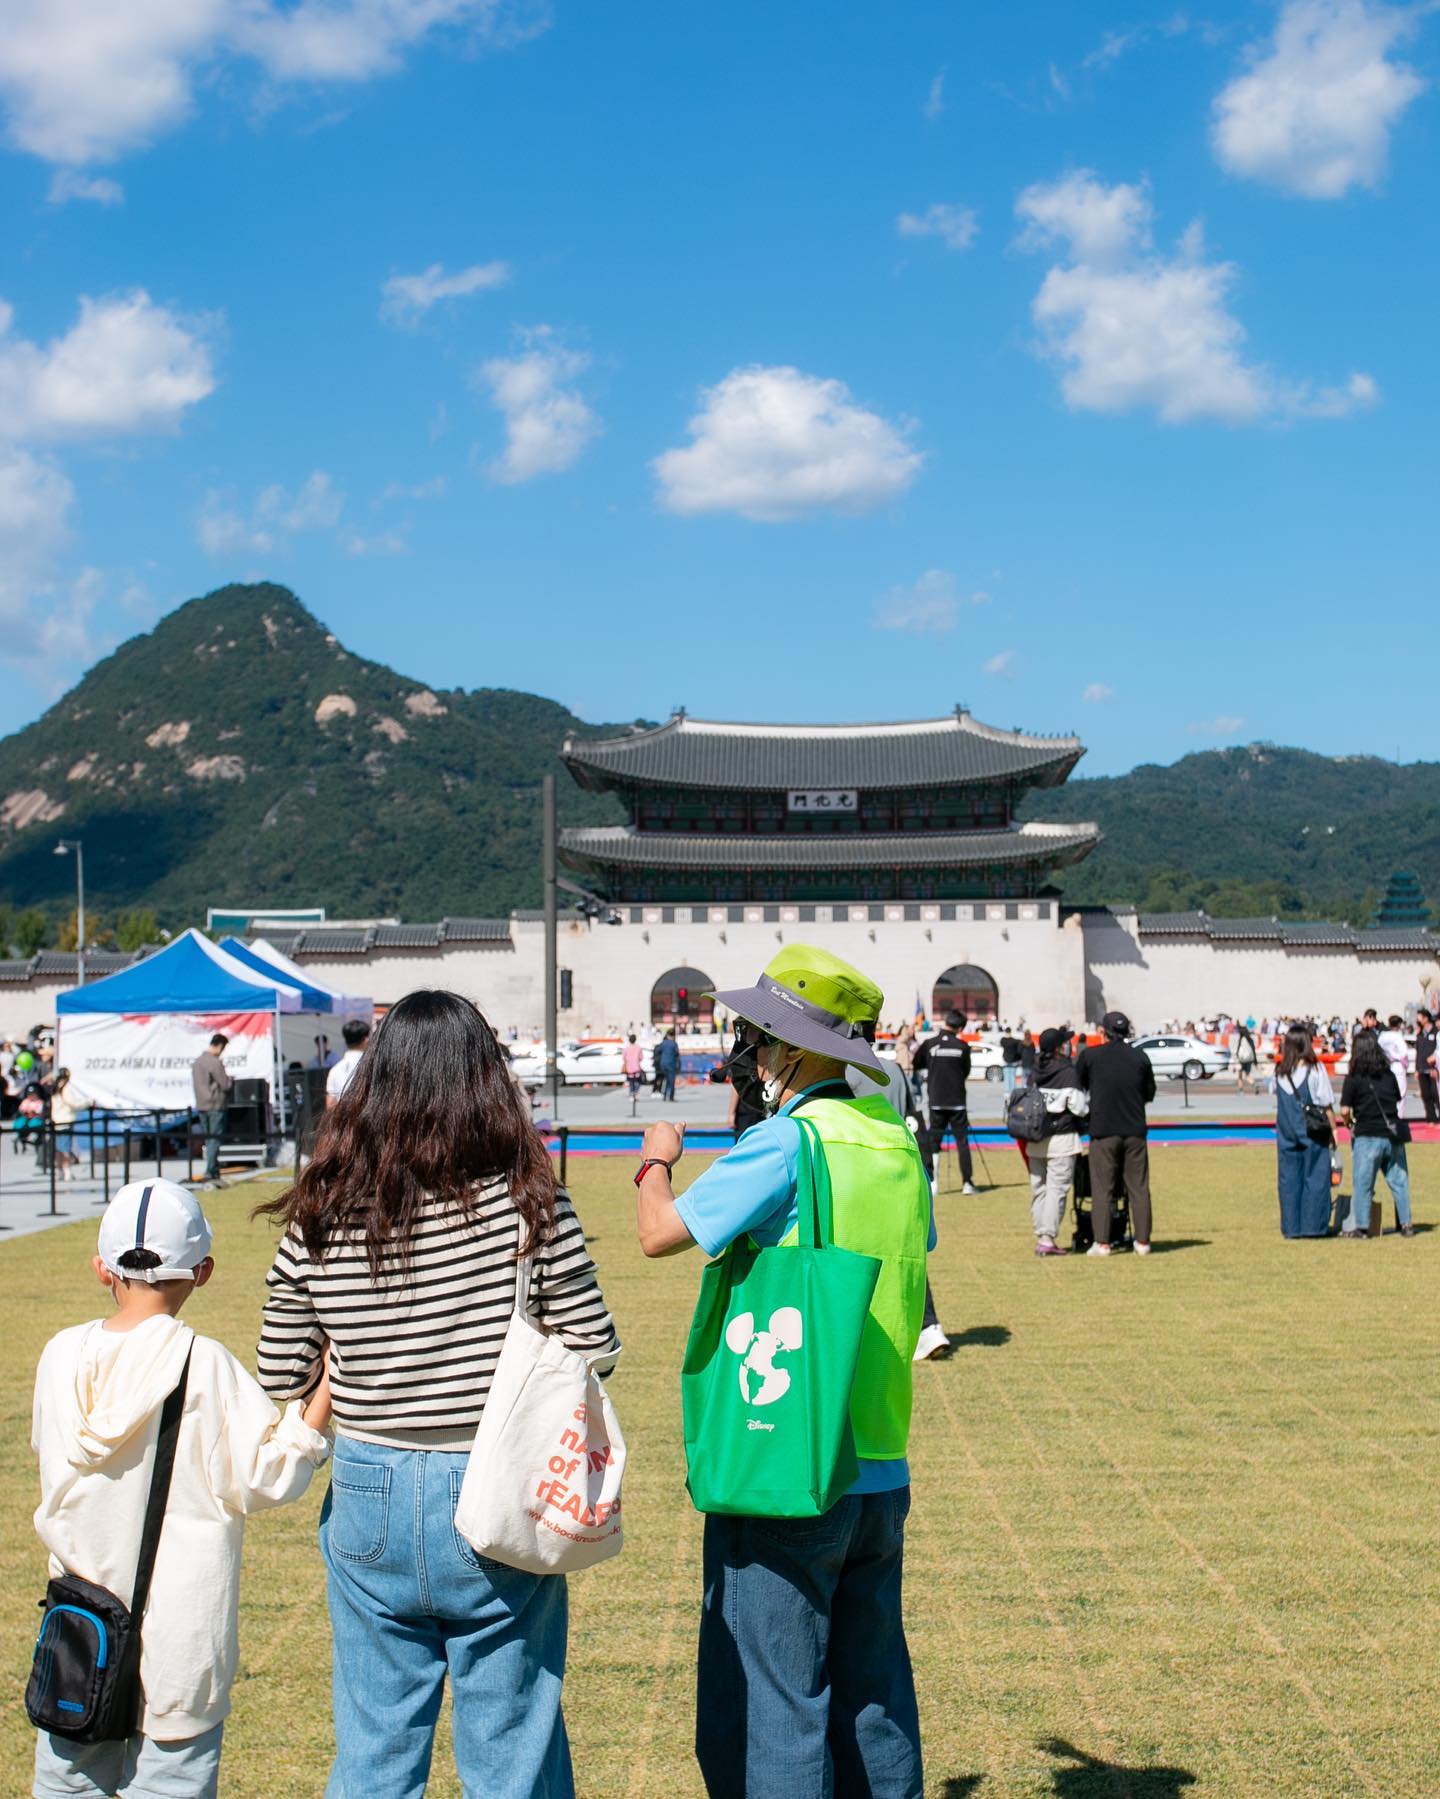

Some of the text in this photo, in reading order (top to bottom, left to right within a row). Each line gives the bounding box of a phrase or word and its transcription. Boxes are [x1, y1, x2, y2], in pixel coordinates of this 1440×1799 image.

[85, 1058, 116, 1070] 2022
[746, 1419, 775, 1433] Disney
[548, 1455, 580, 1480] of
